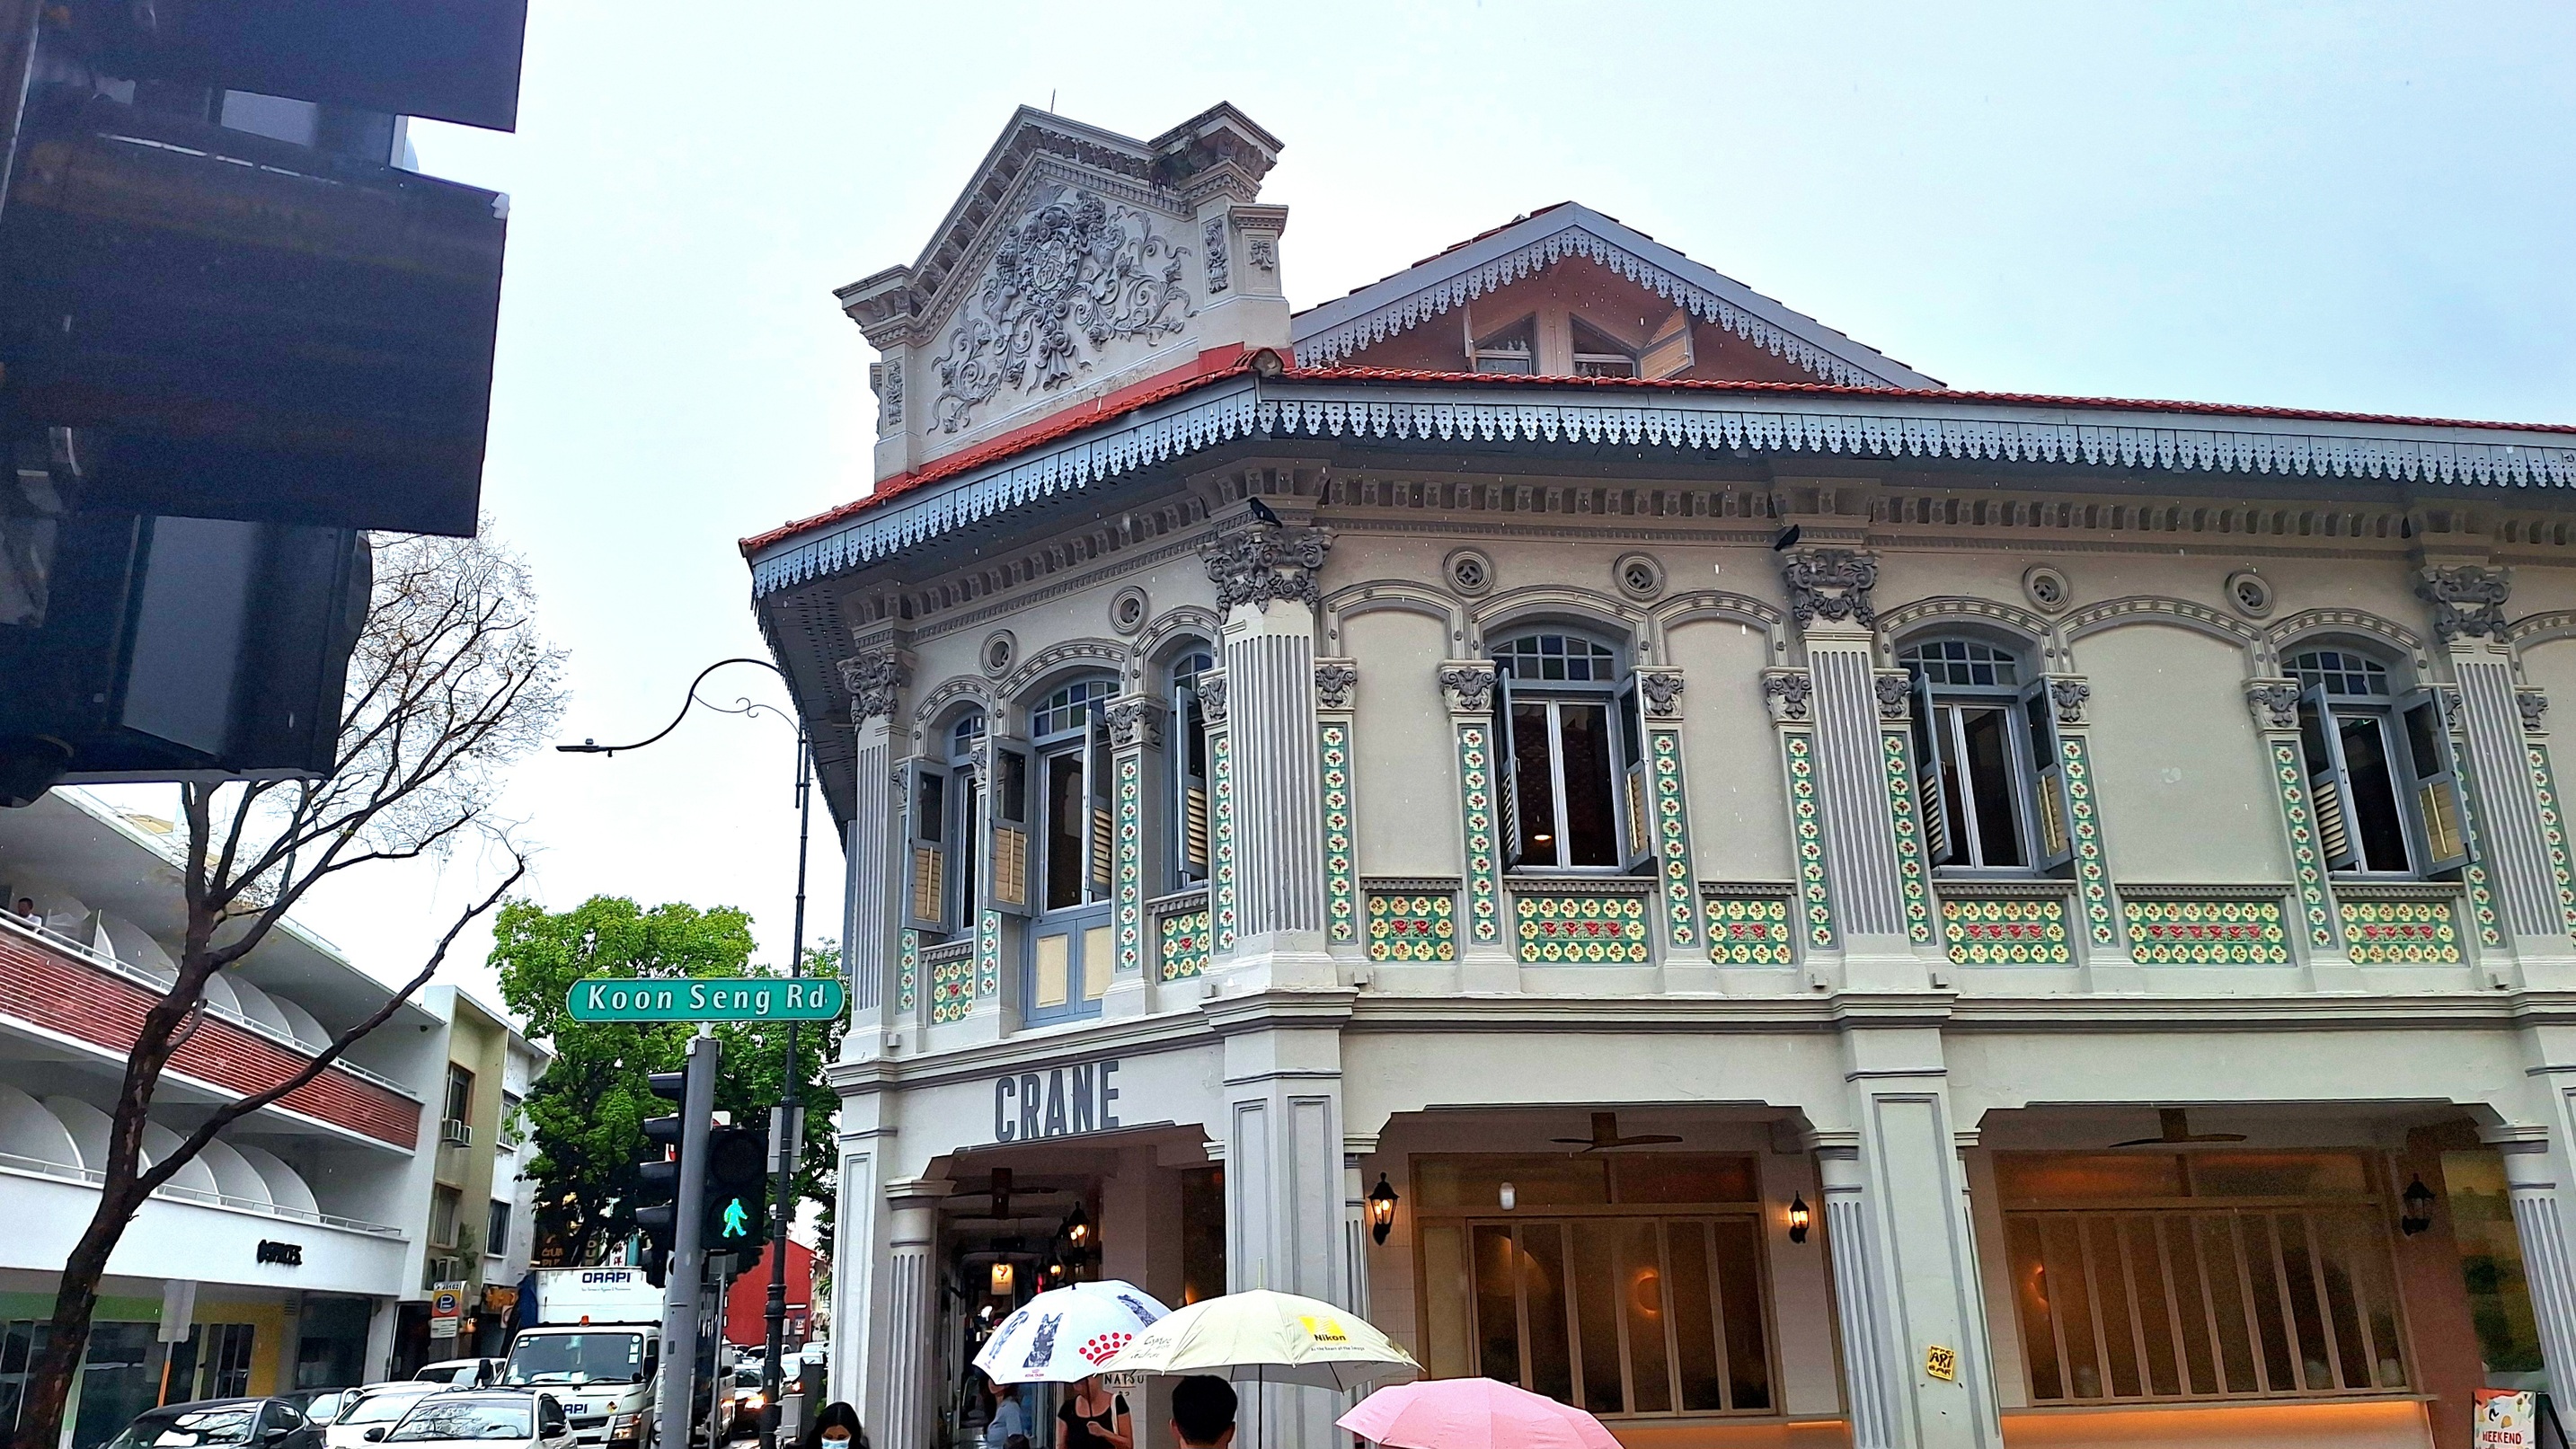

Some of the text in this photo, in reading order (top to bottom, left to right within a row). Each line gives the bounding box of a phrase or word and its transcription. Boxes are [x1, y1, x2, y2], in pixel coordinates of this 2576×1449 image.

[588, 984, 825, 1015] Koon Seng Rd
[996, 1061, 1119, 1143] CRANE
[582, 1272, 631, 1283] ORAPI
[1104, 1374, 1144, 1384] NATSU
[2482, 1430, 2521, 1445] WEEKEND
